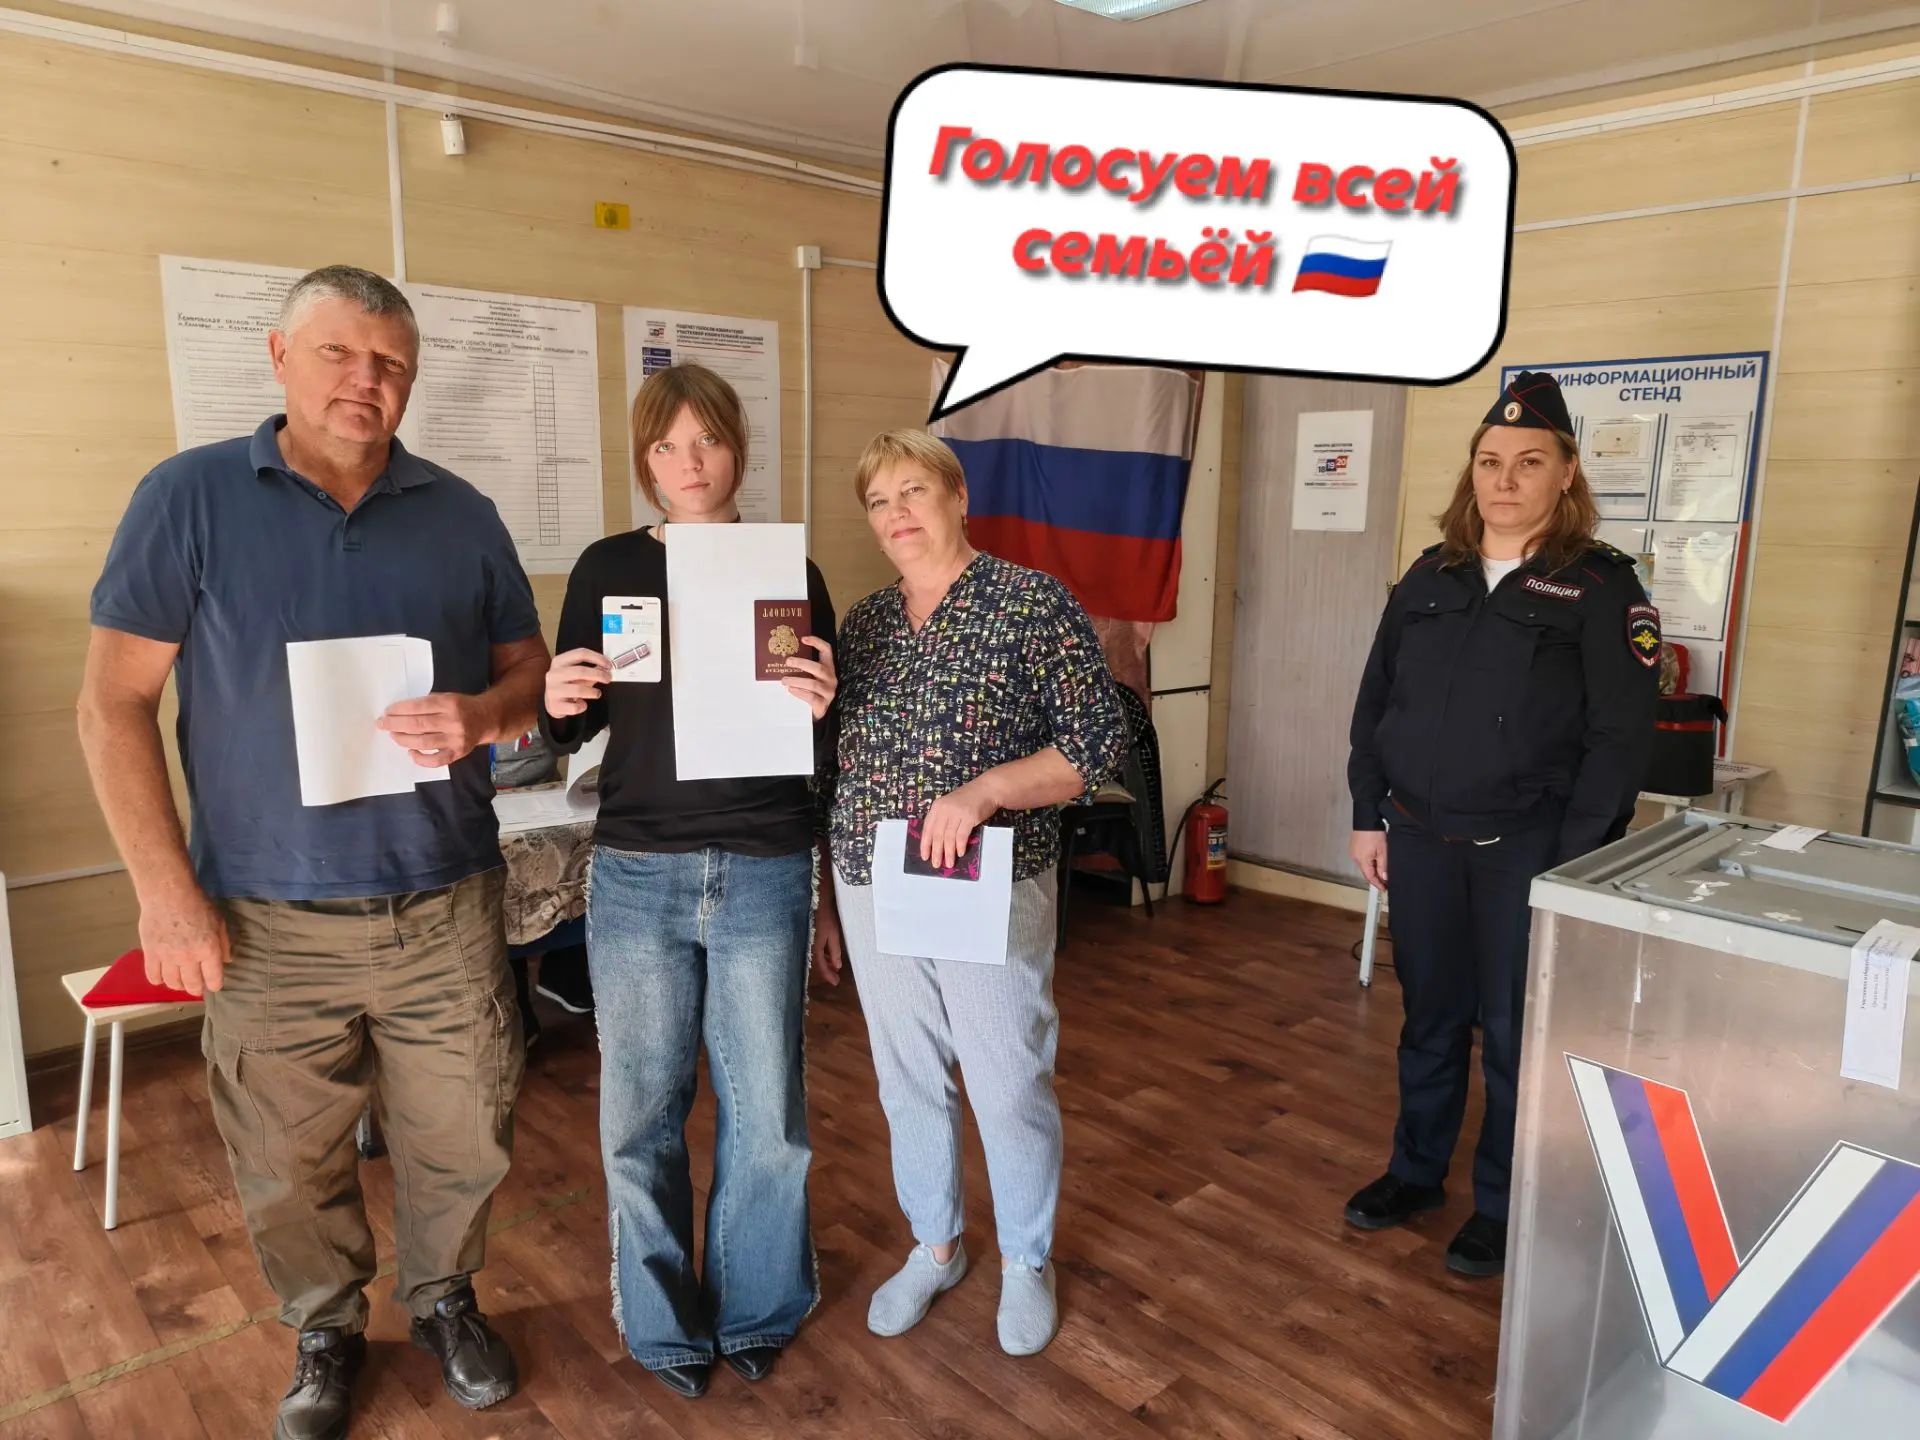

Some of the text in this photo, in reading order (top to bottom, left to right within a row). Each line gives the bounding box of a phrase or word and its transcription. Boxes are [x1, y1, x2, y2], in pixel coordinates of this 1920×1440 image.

[1558, 360, 1756, 388] ИНФОРМАЦИОННЫЙ
[1619, 386, 1682, 402] СТЕНД
[1526, 578, 1581, 599] ПОЛИЦИЯ
[762, 607, 802, 618] ПАСПОРТ
